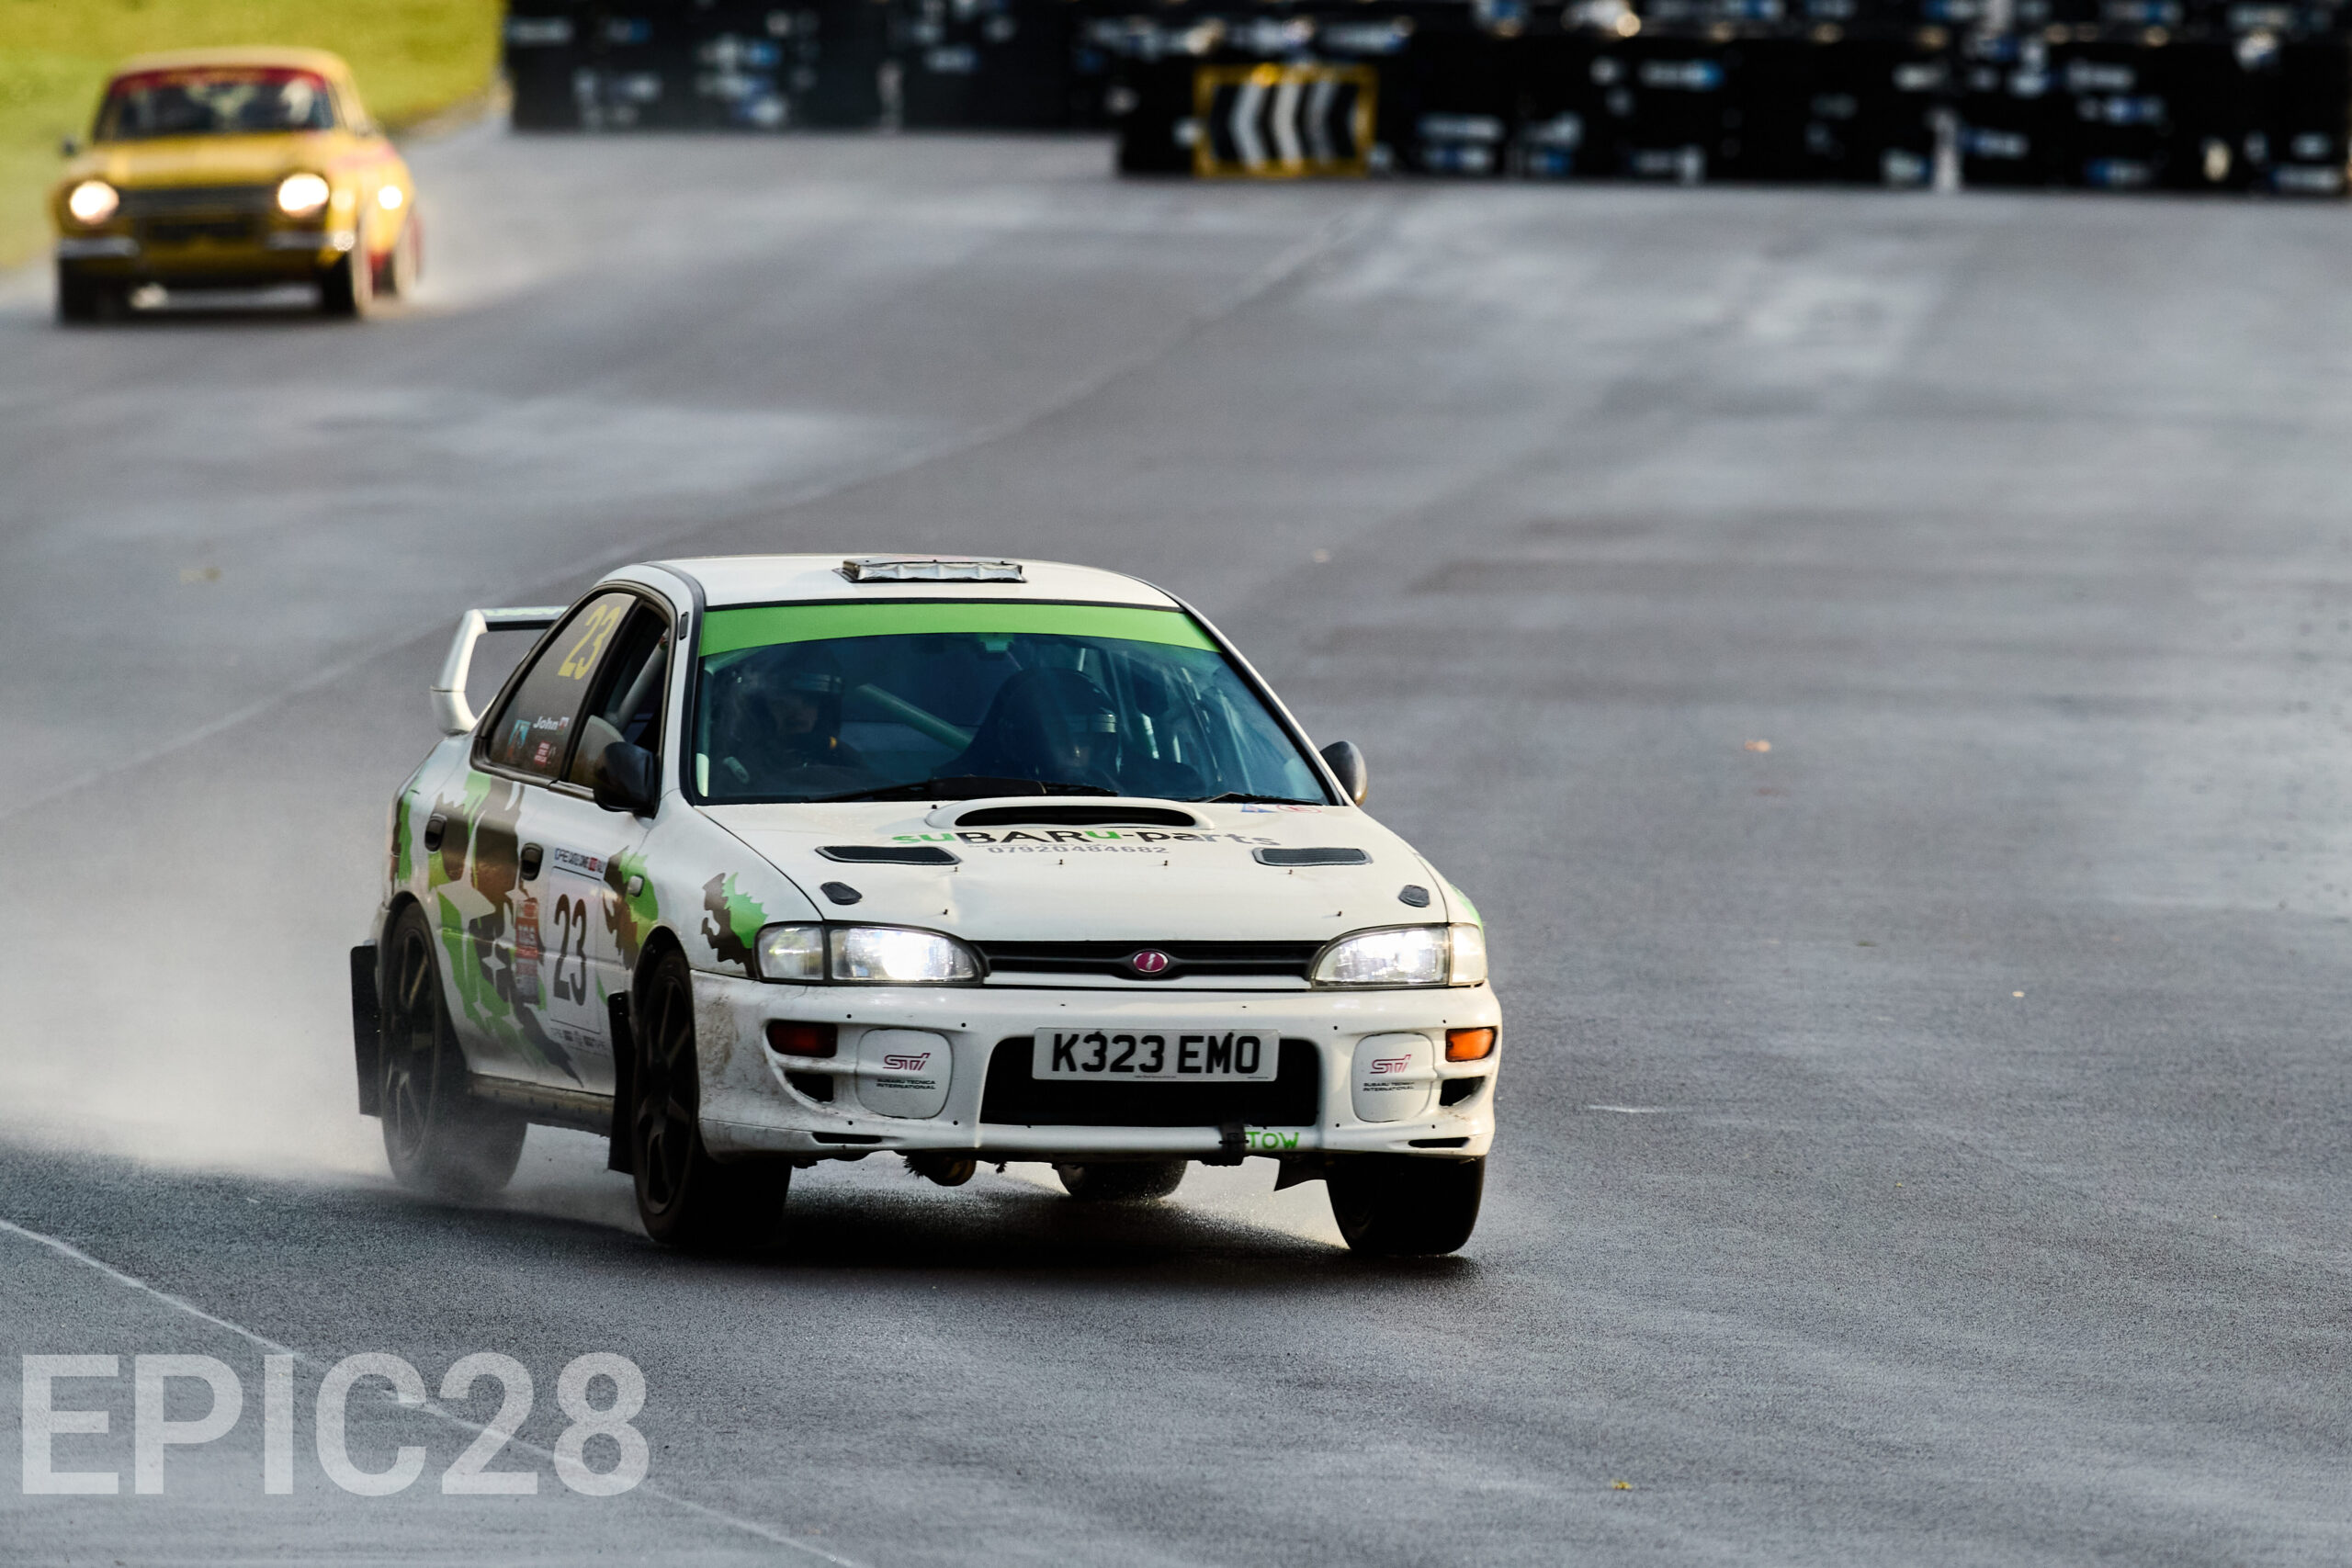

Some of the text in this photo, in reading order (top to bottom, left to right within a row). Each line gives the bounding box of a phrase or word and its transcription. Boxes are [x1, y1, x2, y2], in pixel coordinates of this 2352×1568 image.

[557, 604, 621, 680] 23
[533, 716, 559, 731] John
[554, 894, 586, 1006] 23
[1051, 1032, 1261, 1075] K323 EMO
[1246, 1131, 1300, 1149] TOW
